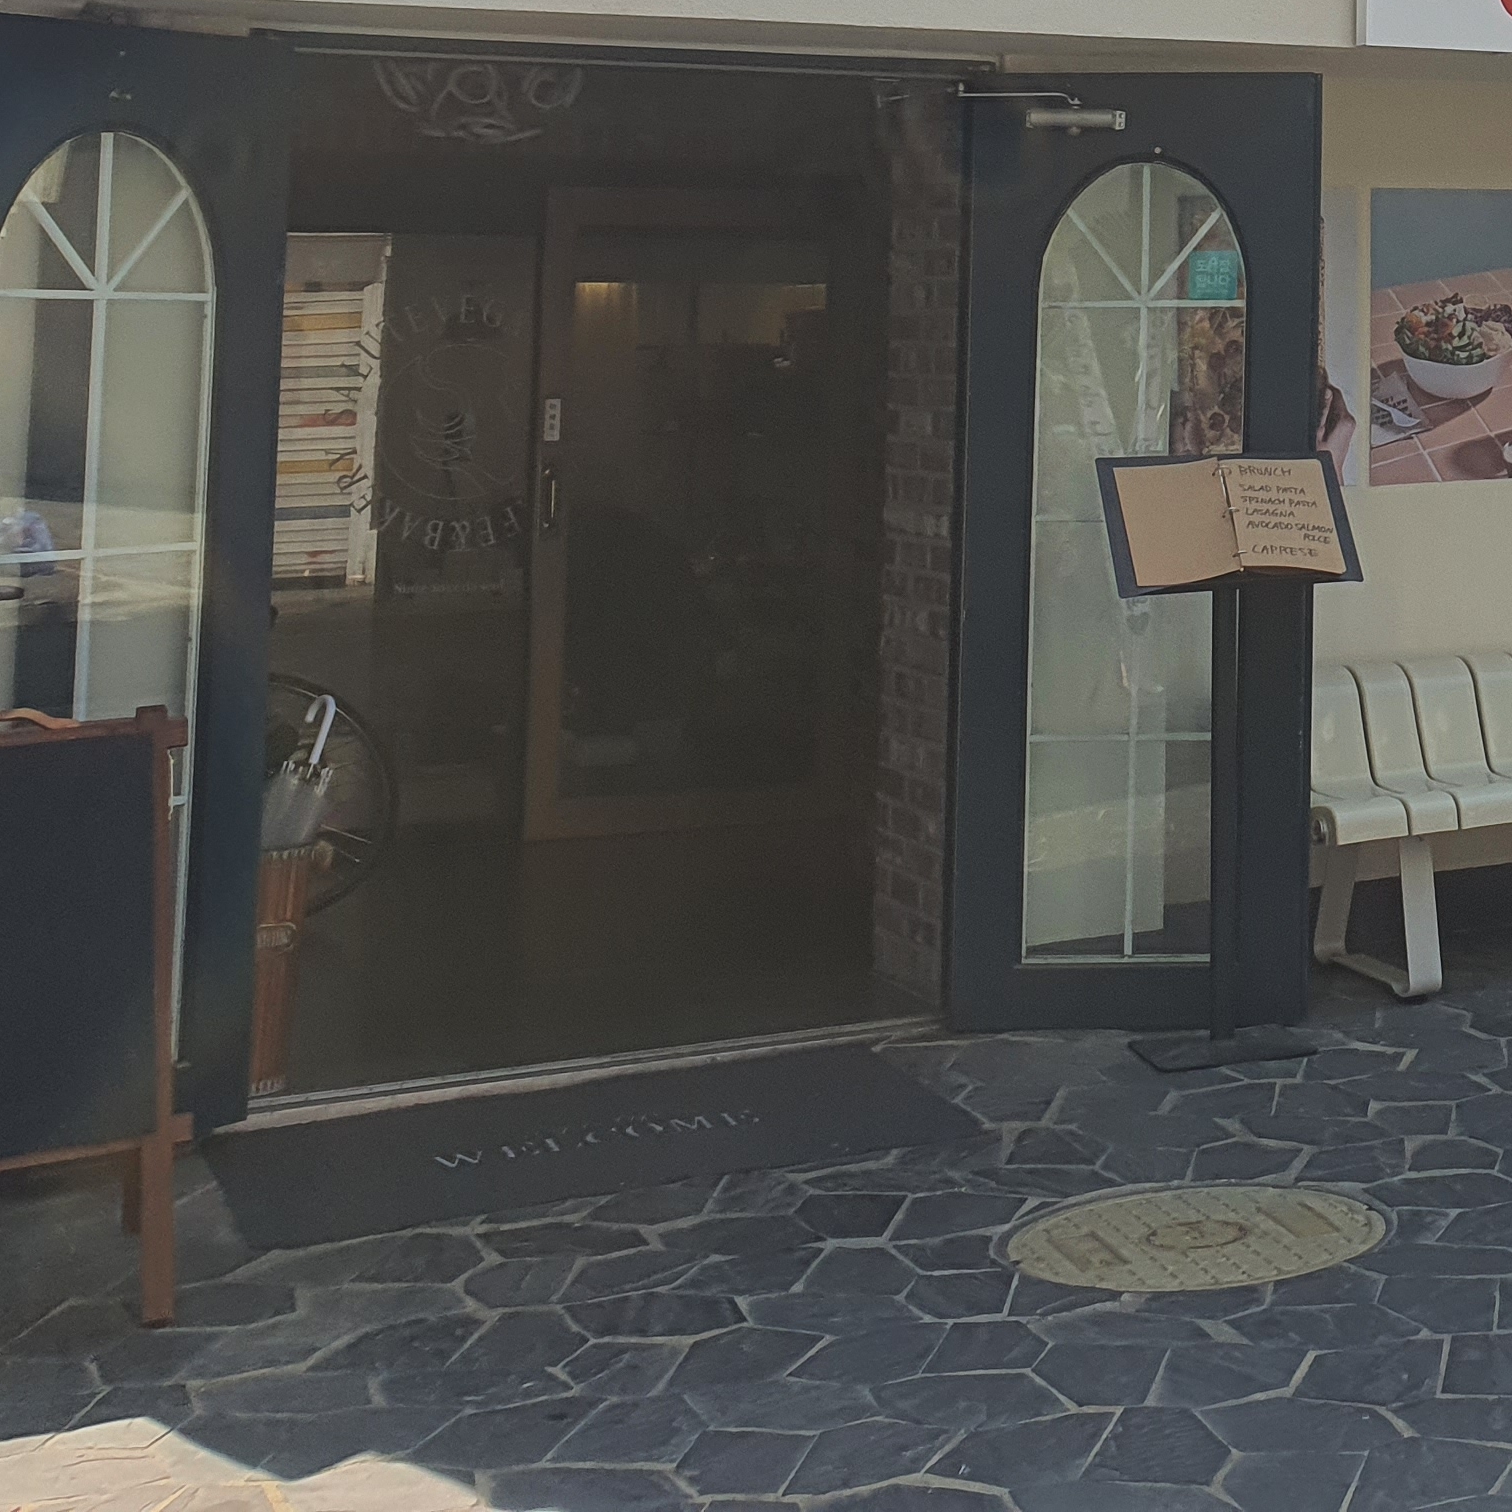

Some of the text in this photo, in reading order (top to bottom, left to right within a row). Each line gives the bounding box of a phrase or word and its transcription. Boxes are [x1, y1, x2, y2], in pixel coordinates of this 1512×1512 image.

[1238, 464, 1292, 477] BRUNCH
[1239, 483, 1306, 496] SALAD PASTA
[1288, 498, 1318, 508] PASTA
[1245, 507, 1296, 518] LASAGNA
[1246, 520, 1334, 534] AVOCADO SALMON
